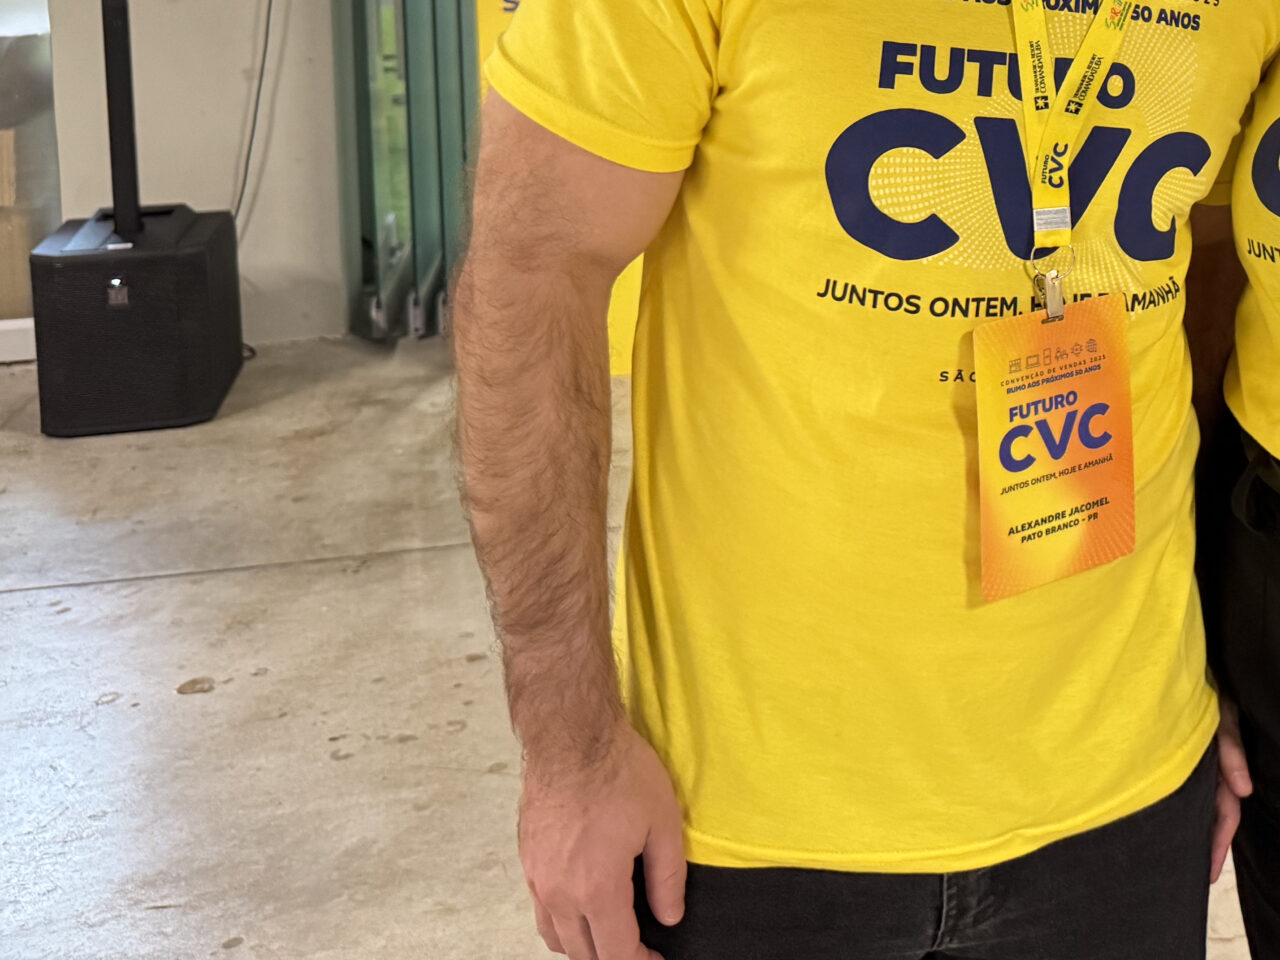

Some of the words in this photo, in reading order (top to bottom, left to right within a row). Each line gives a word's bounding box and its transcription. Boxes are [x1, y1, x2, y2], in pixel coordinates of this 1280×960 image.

[1131, 4, 1153, 23] 50
[1156, 8, 1201, 31] ANOS
[1041, 154, 1050, 184] FUTURO
[1049, 142, 1069, 189] CVC
[825, 108, 1212, 261] CVC
[816, 278, 922, 315] JUNTOS
[1000, 370, 1045, 387] CONVENÇÃO
[1048, 366, 1056, 375] DE
[1059, 359, 1087, 371] VENDAS
[1090, 354, 1107, 364] 2025
[1006, 383, 1026, 395] RUMO
[1027, 380, 1041, 389] AOS
[1041, 370, 1074, 386] PRÓXIMOS
[1075, 370, 1084, 378] 50
[1084, 364, 1101, 375] ANOS
[1009, 390, 1078, 423] FUTURO
[999, 402, 1112, 472] CVC
[1000, 480, 1029, 496] JUNTOS
[1031, 472, 1058, 486] ONTEM,
[1058, 465, 1077, 477] HOJE
[1083, 453, 1113, 469] AMANHÃ
[1008, 510, 1067, 536] ALEXANDRE
[1069, 497, 1110, 517] JACOMEL
[1021, 530, 1043, 544] PATO
[1045, 518, 1080, 537] BRANCO
[1087, 512, 1099, 522] PR
